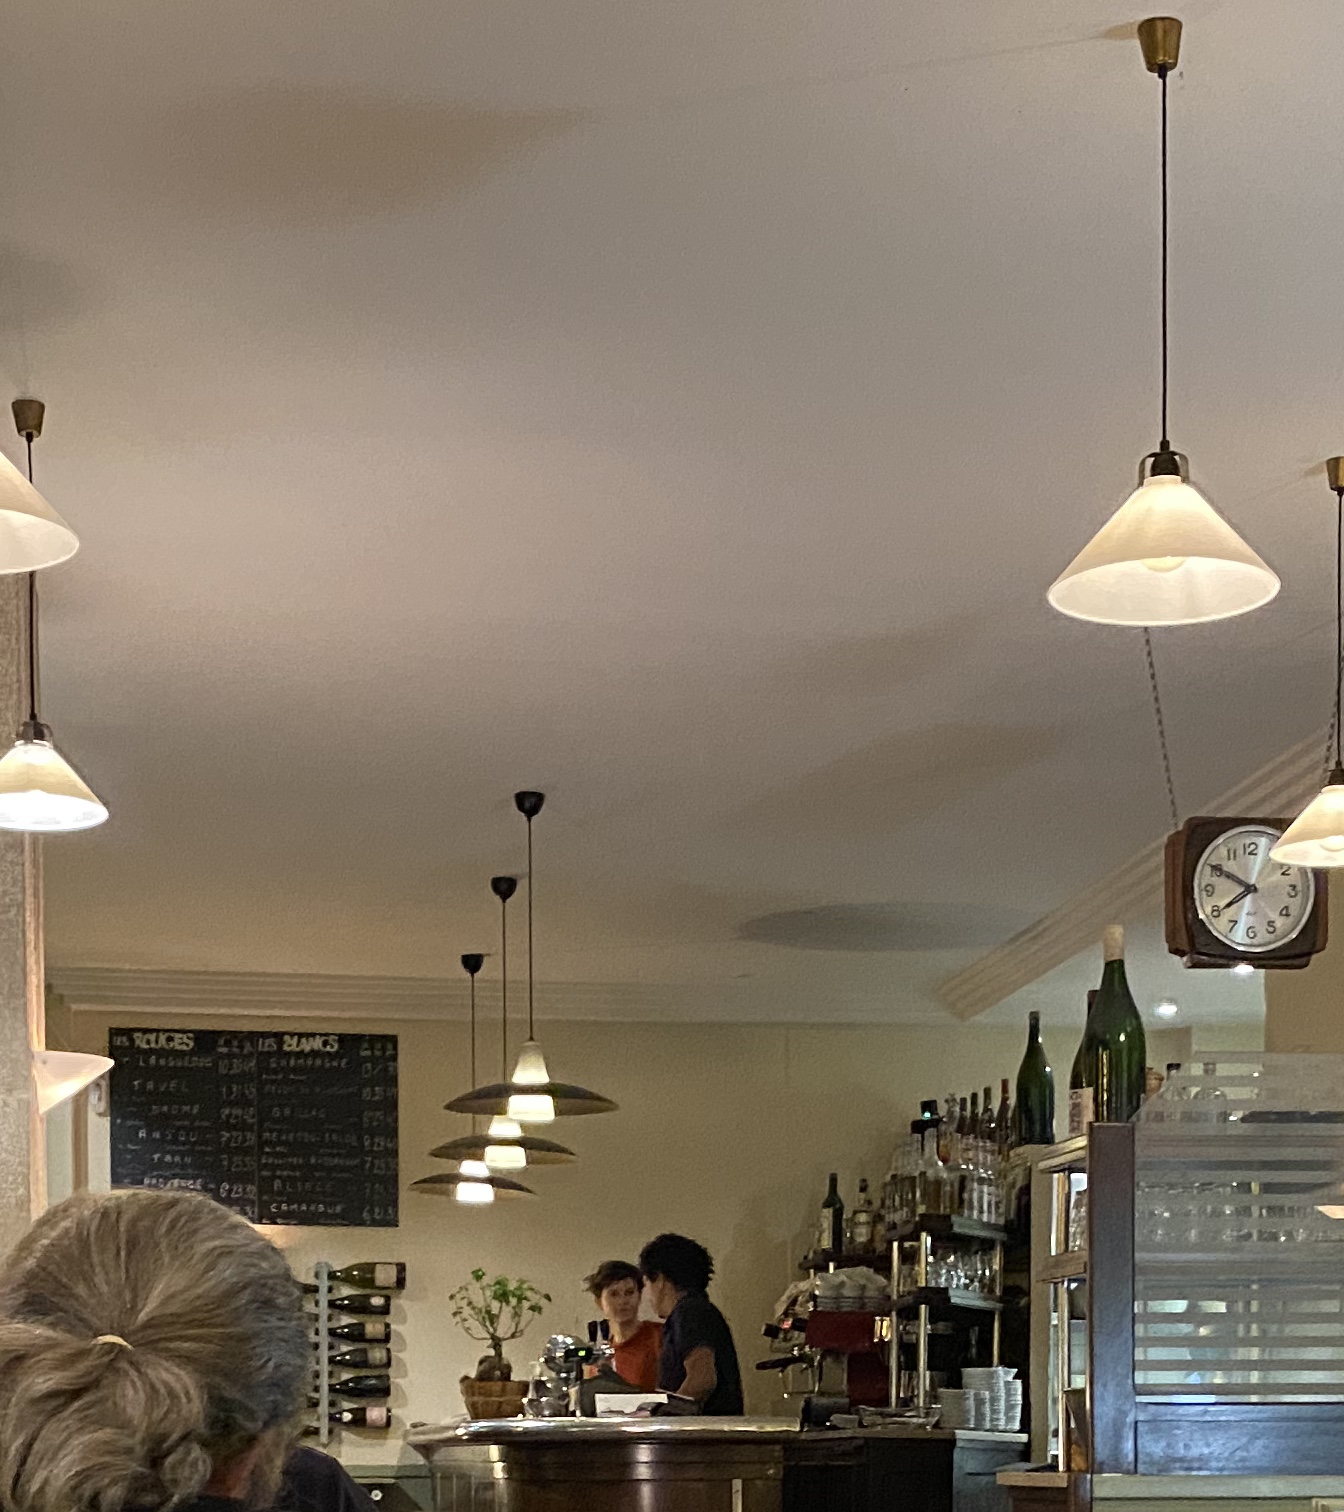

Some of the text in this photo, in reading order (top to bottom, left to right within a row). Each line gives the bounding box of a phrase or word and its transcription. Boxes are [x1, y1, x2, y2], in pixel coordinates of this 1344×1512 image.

[1226, 849, 1237, 861] 11
[1242, 842, 1258, 856] 12
[1280, 864, 1292, 877] 2
[1204, 883, 1215, 898] 9
[1287, 884, 1299, 899] 3
[1210, 904, 1222, 919] 8
[1279, 905, 1292, 918] 4
[1228, 919, 1238, 933] 7
[1246, 926, 1257, 940] 6
[1266, 920, 1276, 934] 5
[132, 1031, 195, 1051] ROUGES
[282, 1034, 339, 1053] BLANCS
